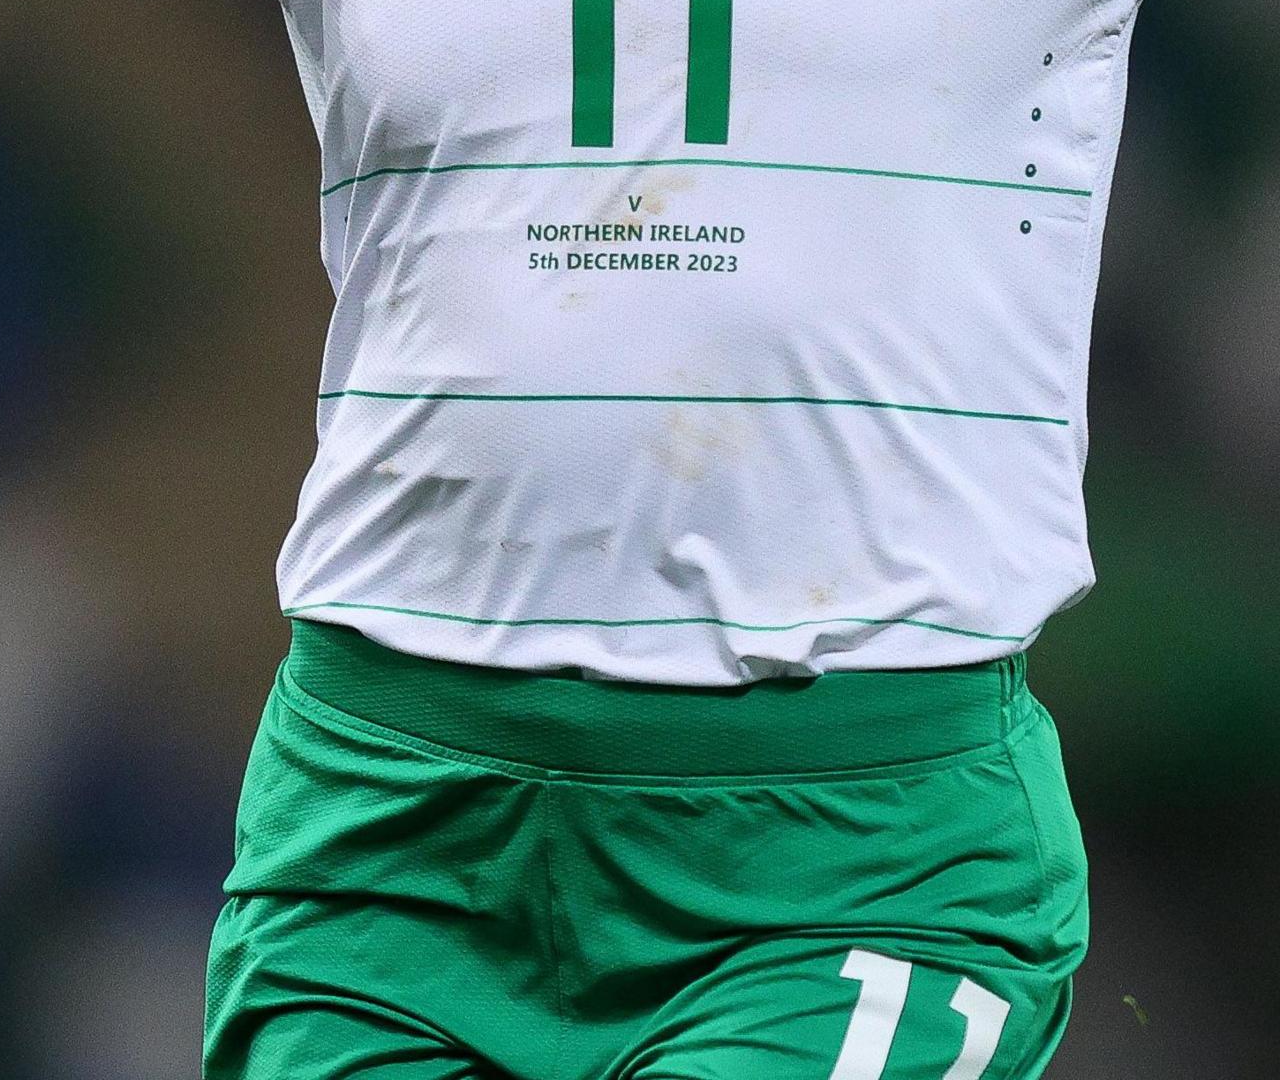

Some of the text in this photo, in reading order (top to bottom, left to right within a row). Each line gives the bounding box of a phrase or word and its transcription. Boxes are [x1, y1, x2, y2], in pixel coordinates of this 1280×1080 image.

[628, 195, 642, 212] V
[527, 224, 745, 243] NORTHERN IRELAND
[528, 252, 738, 272] 5th DECEMBER 2023
